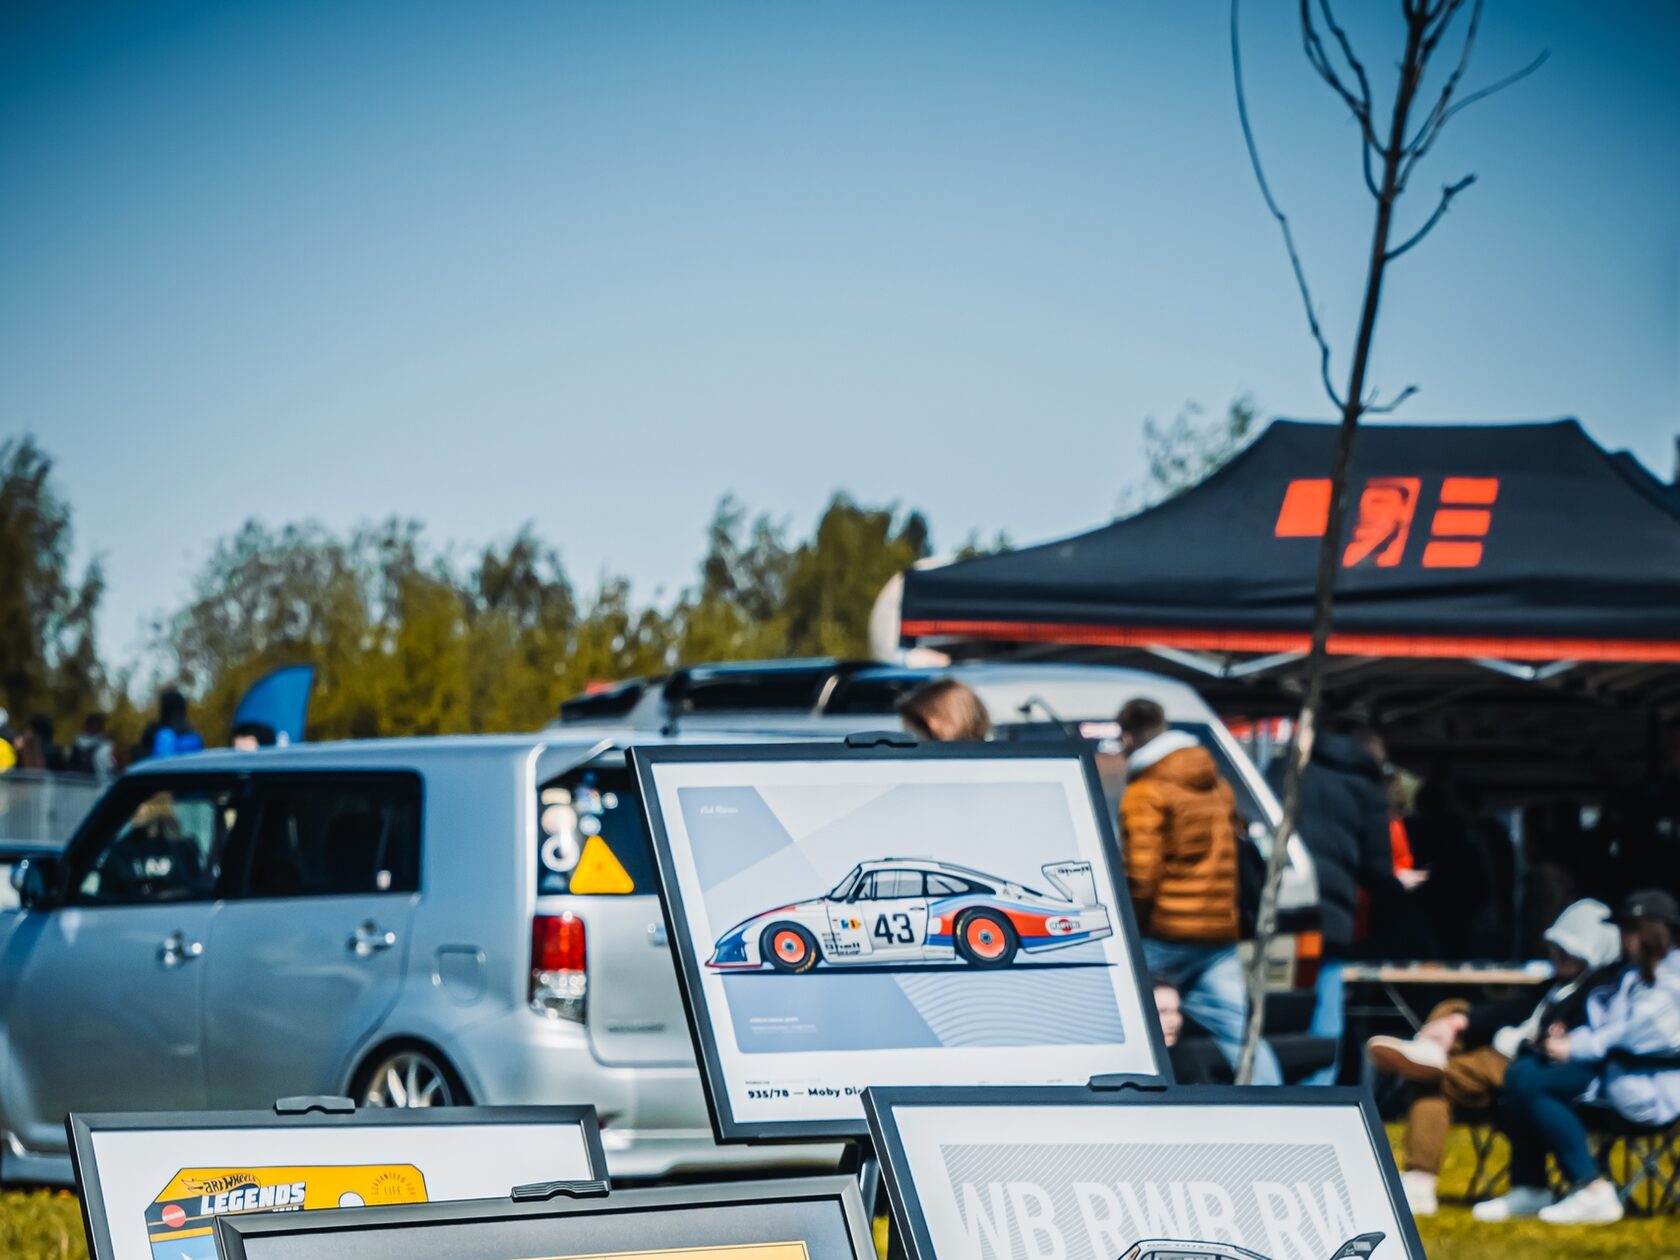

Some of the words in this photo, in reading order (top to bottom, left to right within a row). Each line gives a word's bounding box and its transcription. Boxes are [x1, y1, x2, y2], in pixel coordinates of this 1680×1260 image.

[874, 913, 915, 944] 43
[748, 1089, 789, 1099] 935/78
[808, 1087, 840, 1098] Moby
[200, 1182, 306, 1215] LEGENDS
[384, 1186, 401, 1196] LIFE
